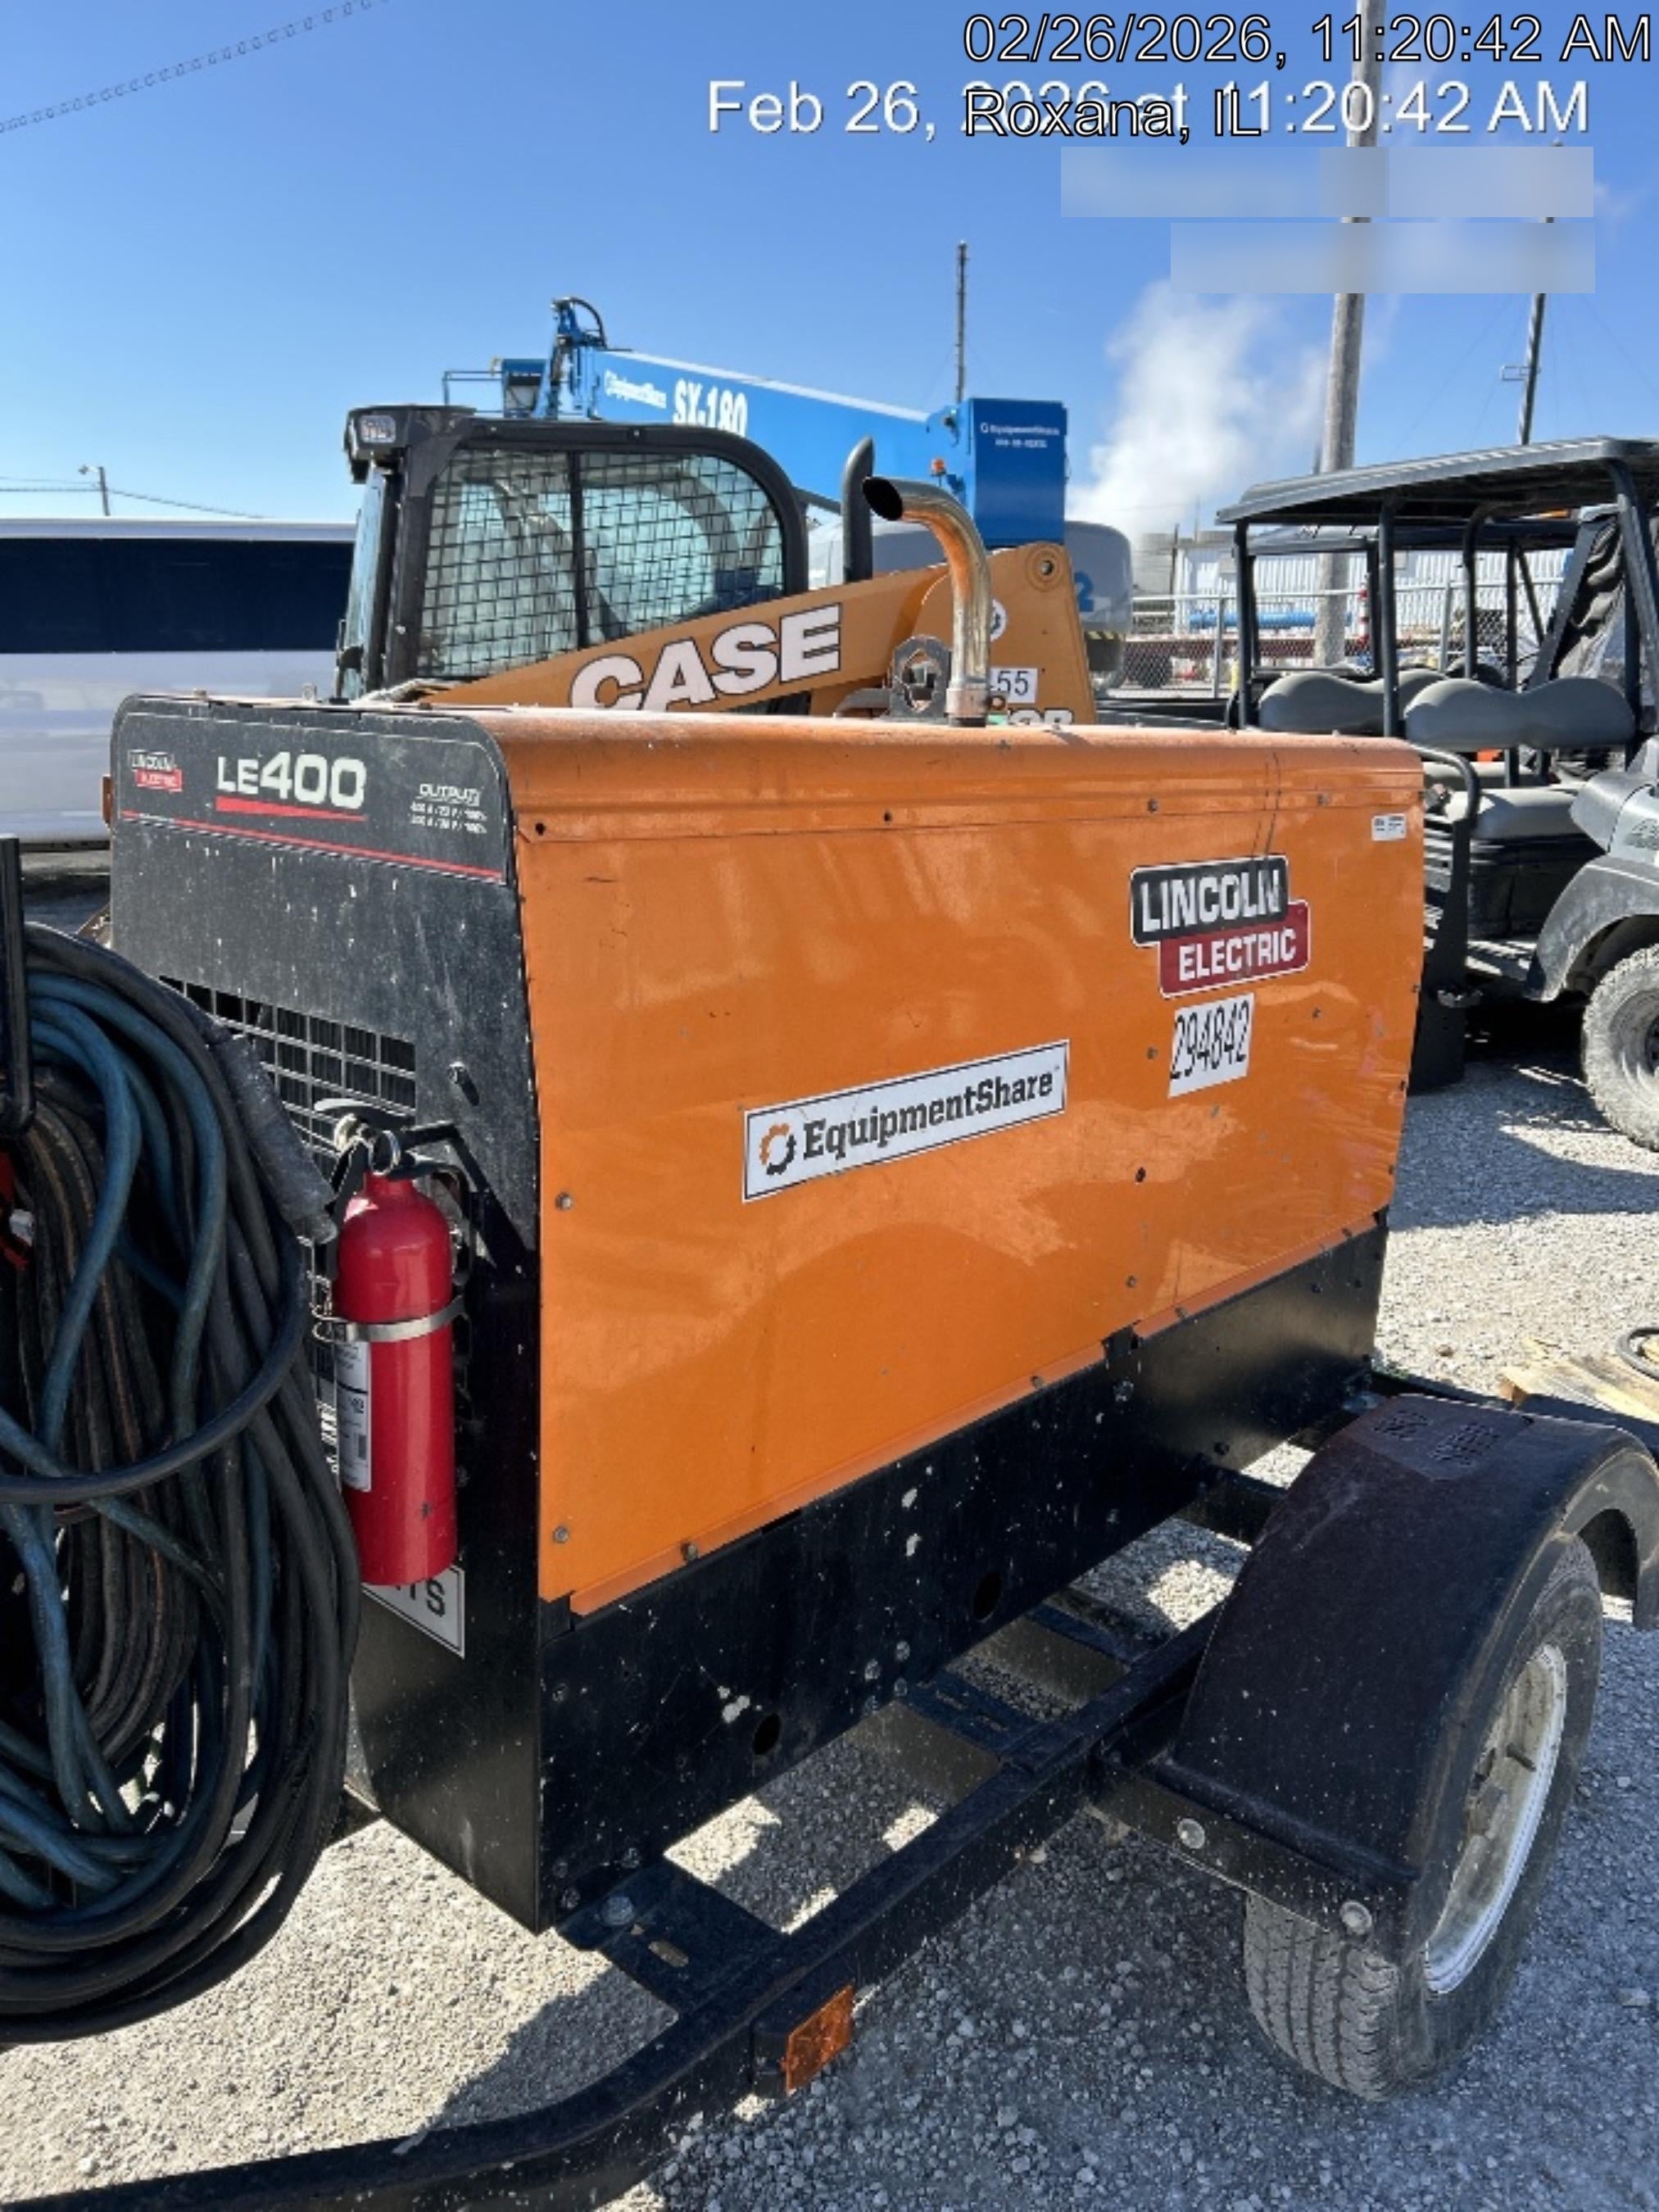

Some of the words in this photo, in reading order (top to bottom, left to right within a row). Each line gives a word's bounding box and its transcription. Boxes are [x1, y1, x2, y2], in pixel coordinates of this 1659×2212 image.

[569, 604, 844, 712] CASE
[990, 670, 1030, 696] 55
[216, 750, 367, 809] LE400
[1139, 868, 1281, 933] LINCOLN
[1178, 927, 1298, 982] ELECTRIC
[1169, 999, 1250, 1080] 294842
[802, 1069, 1054, 1163] EquipmentShare
